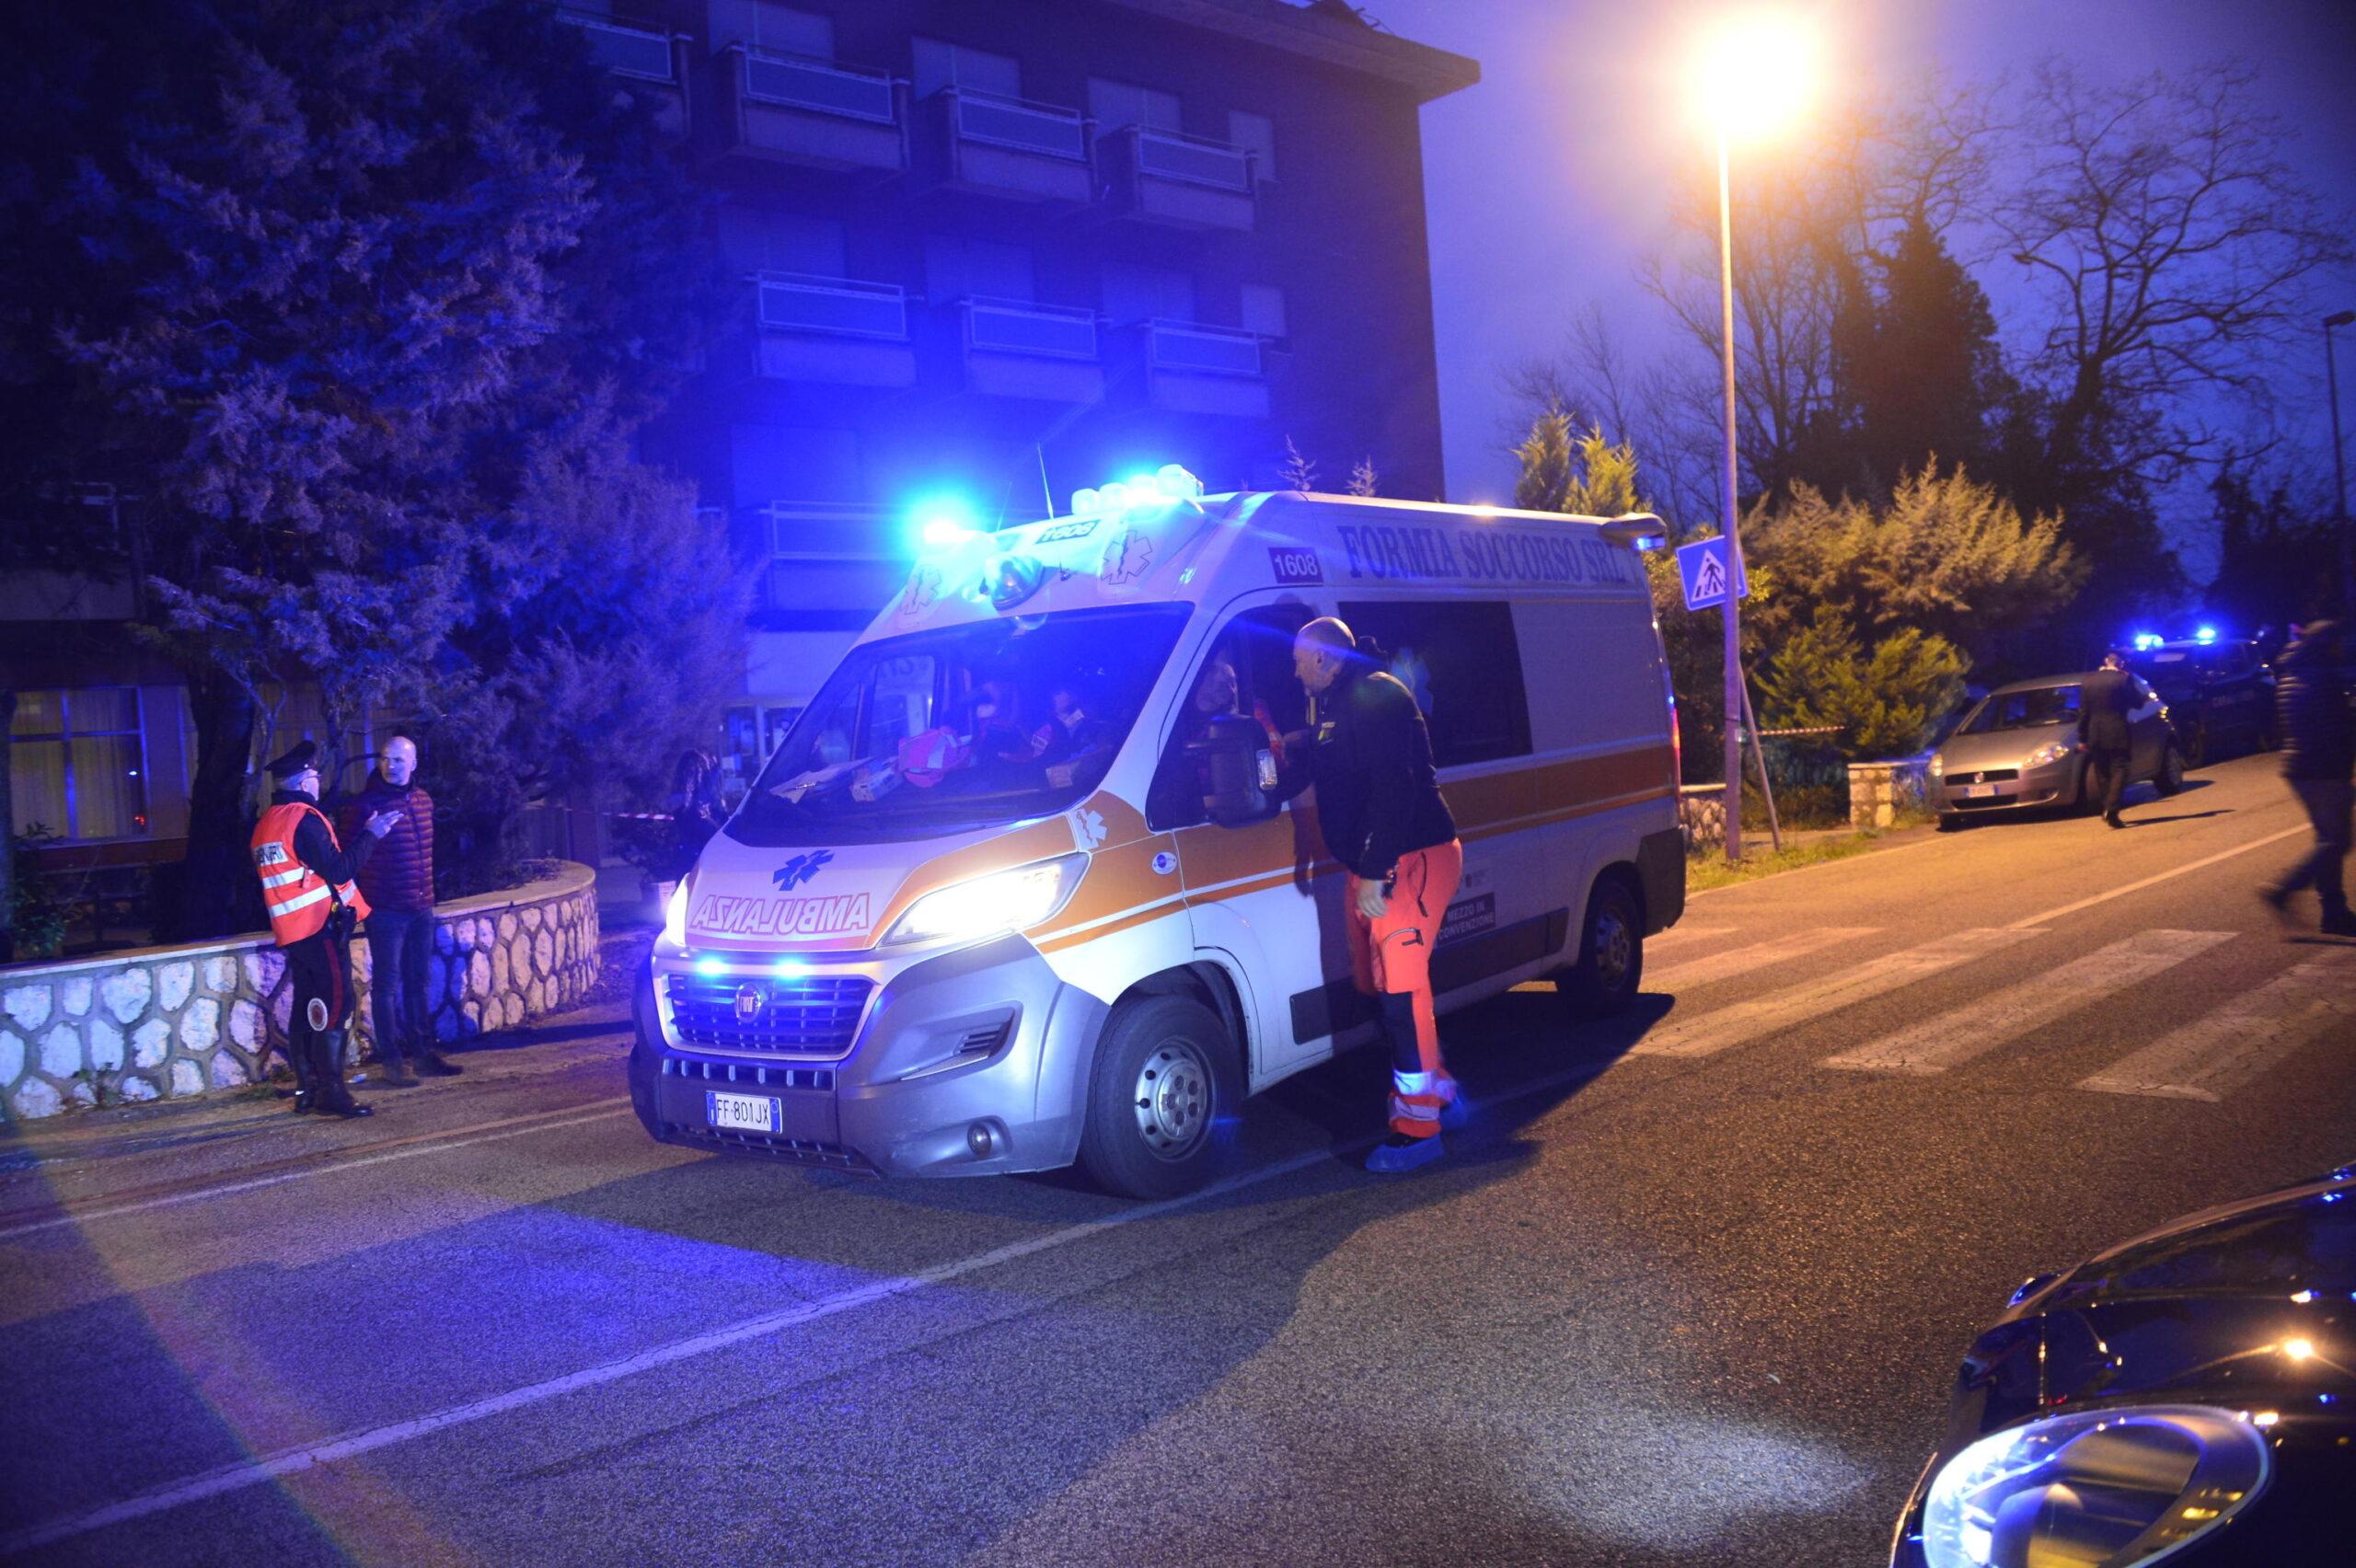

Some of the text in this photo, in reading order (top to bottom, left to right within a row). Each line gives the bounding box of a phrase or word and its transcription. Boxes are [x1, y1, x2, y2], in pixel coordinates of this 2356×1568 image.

[1275, 554, 1318, 576] 1608
[1337, 525, 1461, 578] FORMIA
[1460, 530, 1582, 582] SOCCORSO
[1448, 900, 1485, 922] MEZZO IN
[1438, 912, 1495, 940] CONVENZIONE
